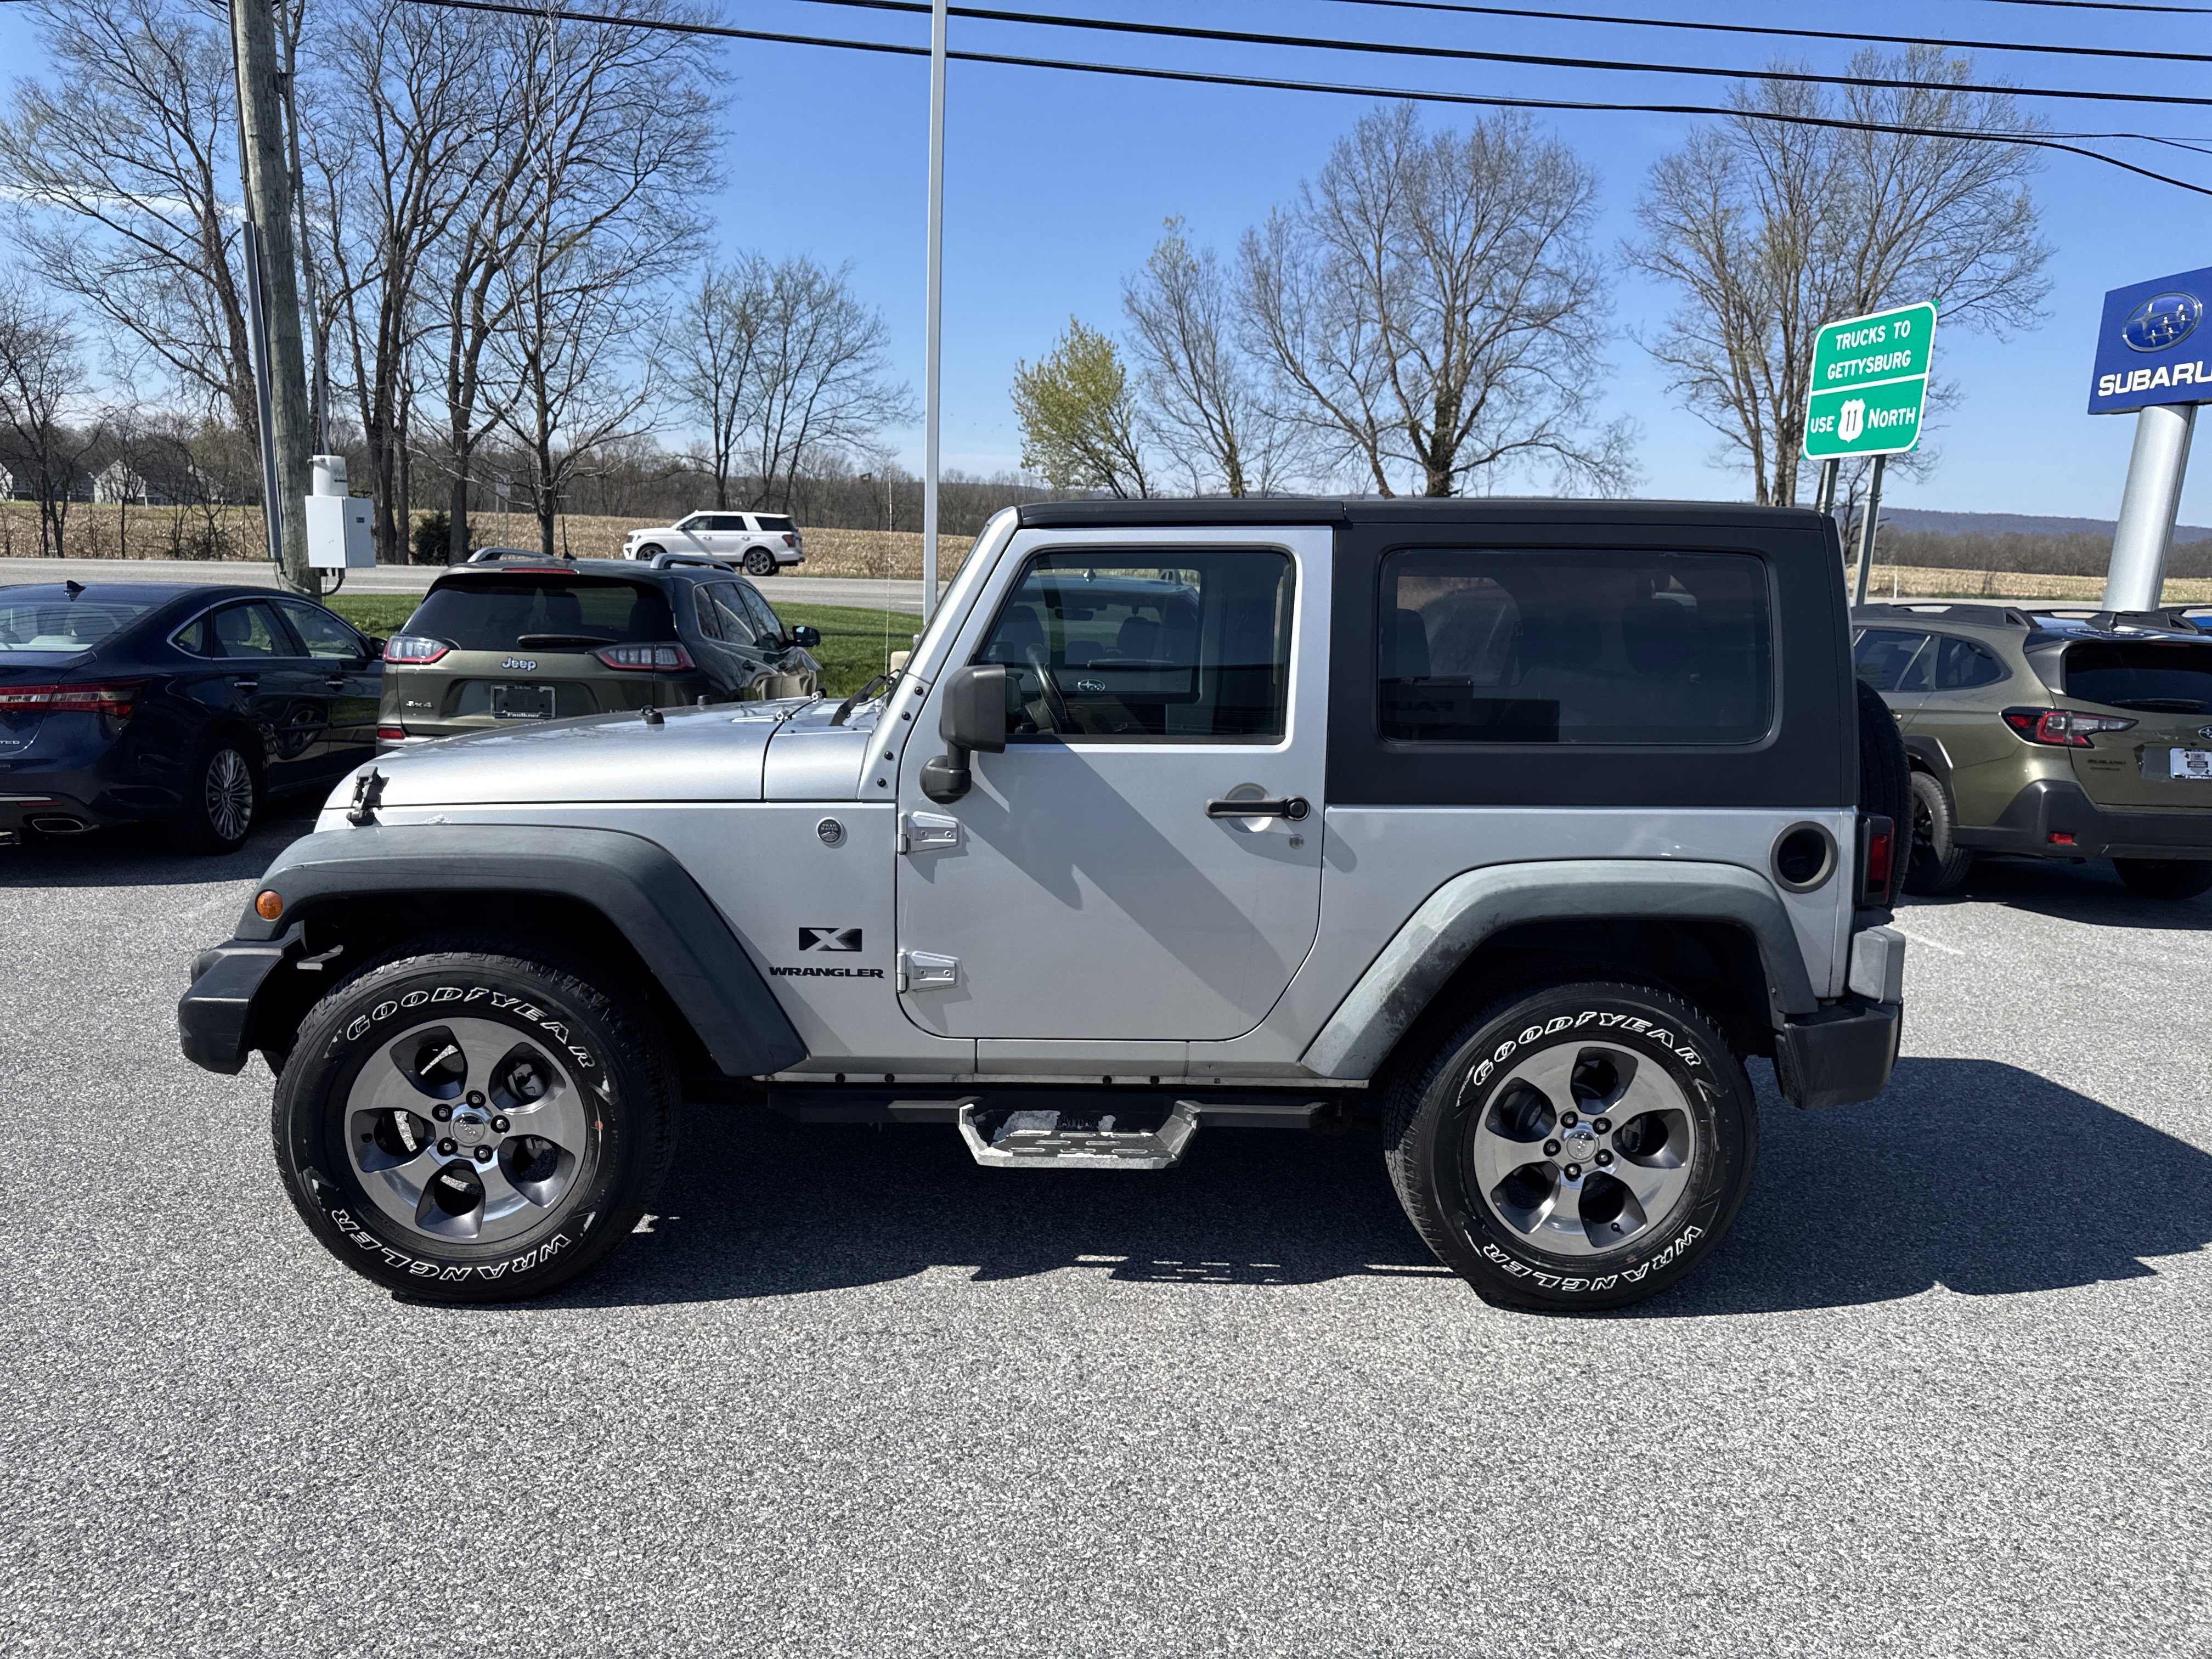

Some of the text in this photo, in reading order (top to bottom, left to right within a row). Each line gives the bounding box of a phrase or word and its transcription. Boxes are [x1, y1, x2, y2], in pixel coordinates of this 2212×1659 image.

[1836, 320, 1911, 351] TRUCKS TO
[1827, 349, 1911, 380] GETTYSBURG
[2098, 360, 2212, 397] SUBARU
[1810, 407, 1916, 433] USE 11 NORTH
[501, 657, 537, 672] Jeep
[769, 967, 885, 979] WRANGLER
[346, 986, 595, 1069] GOODYEAR
[1474, 1012, 1702, 1087] GOODYEAR
[331, 1208, 572, 1283] WRANGLER
[1482, 1224, 1705, 1293] WRANGLER
